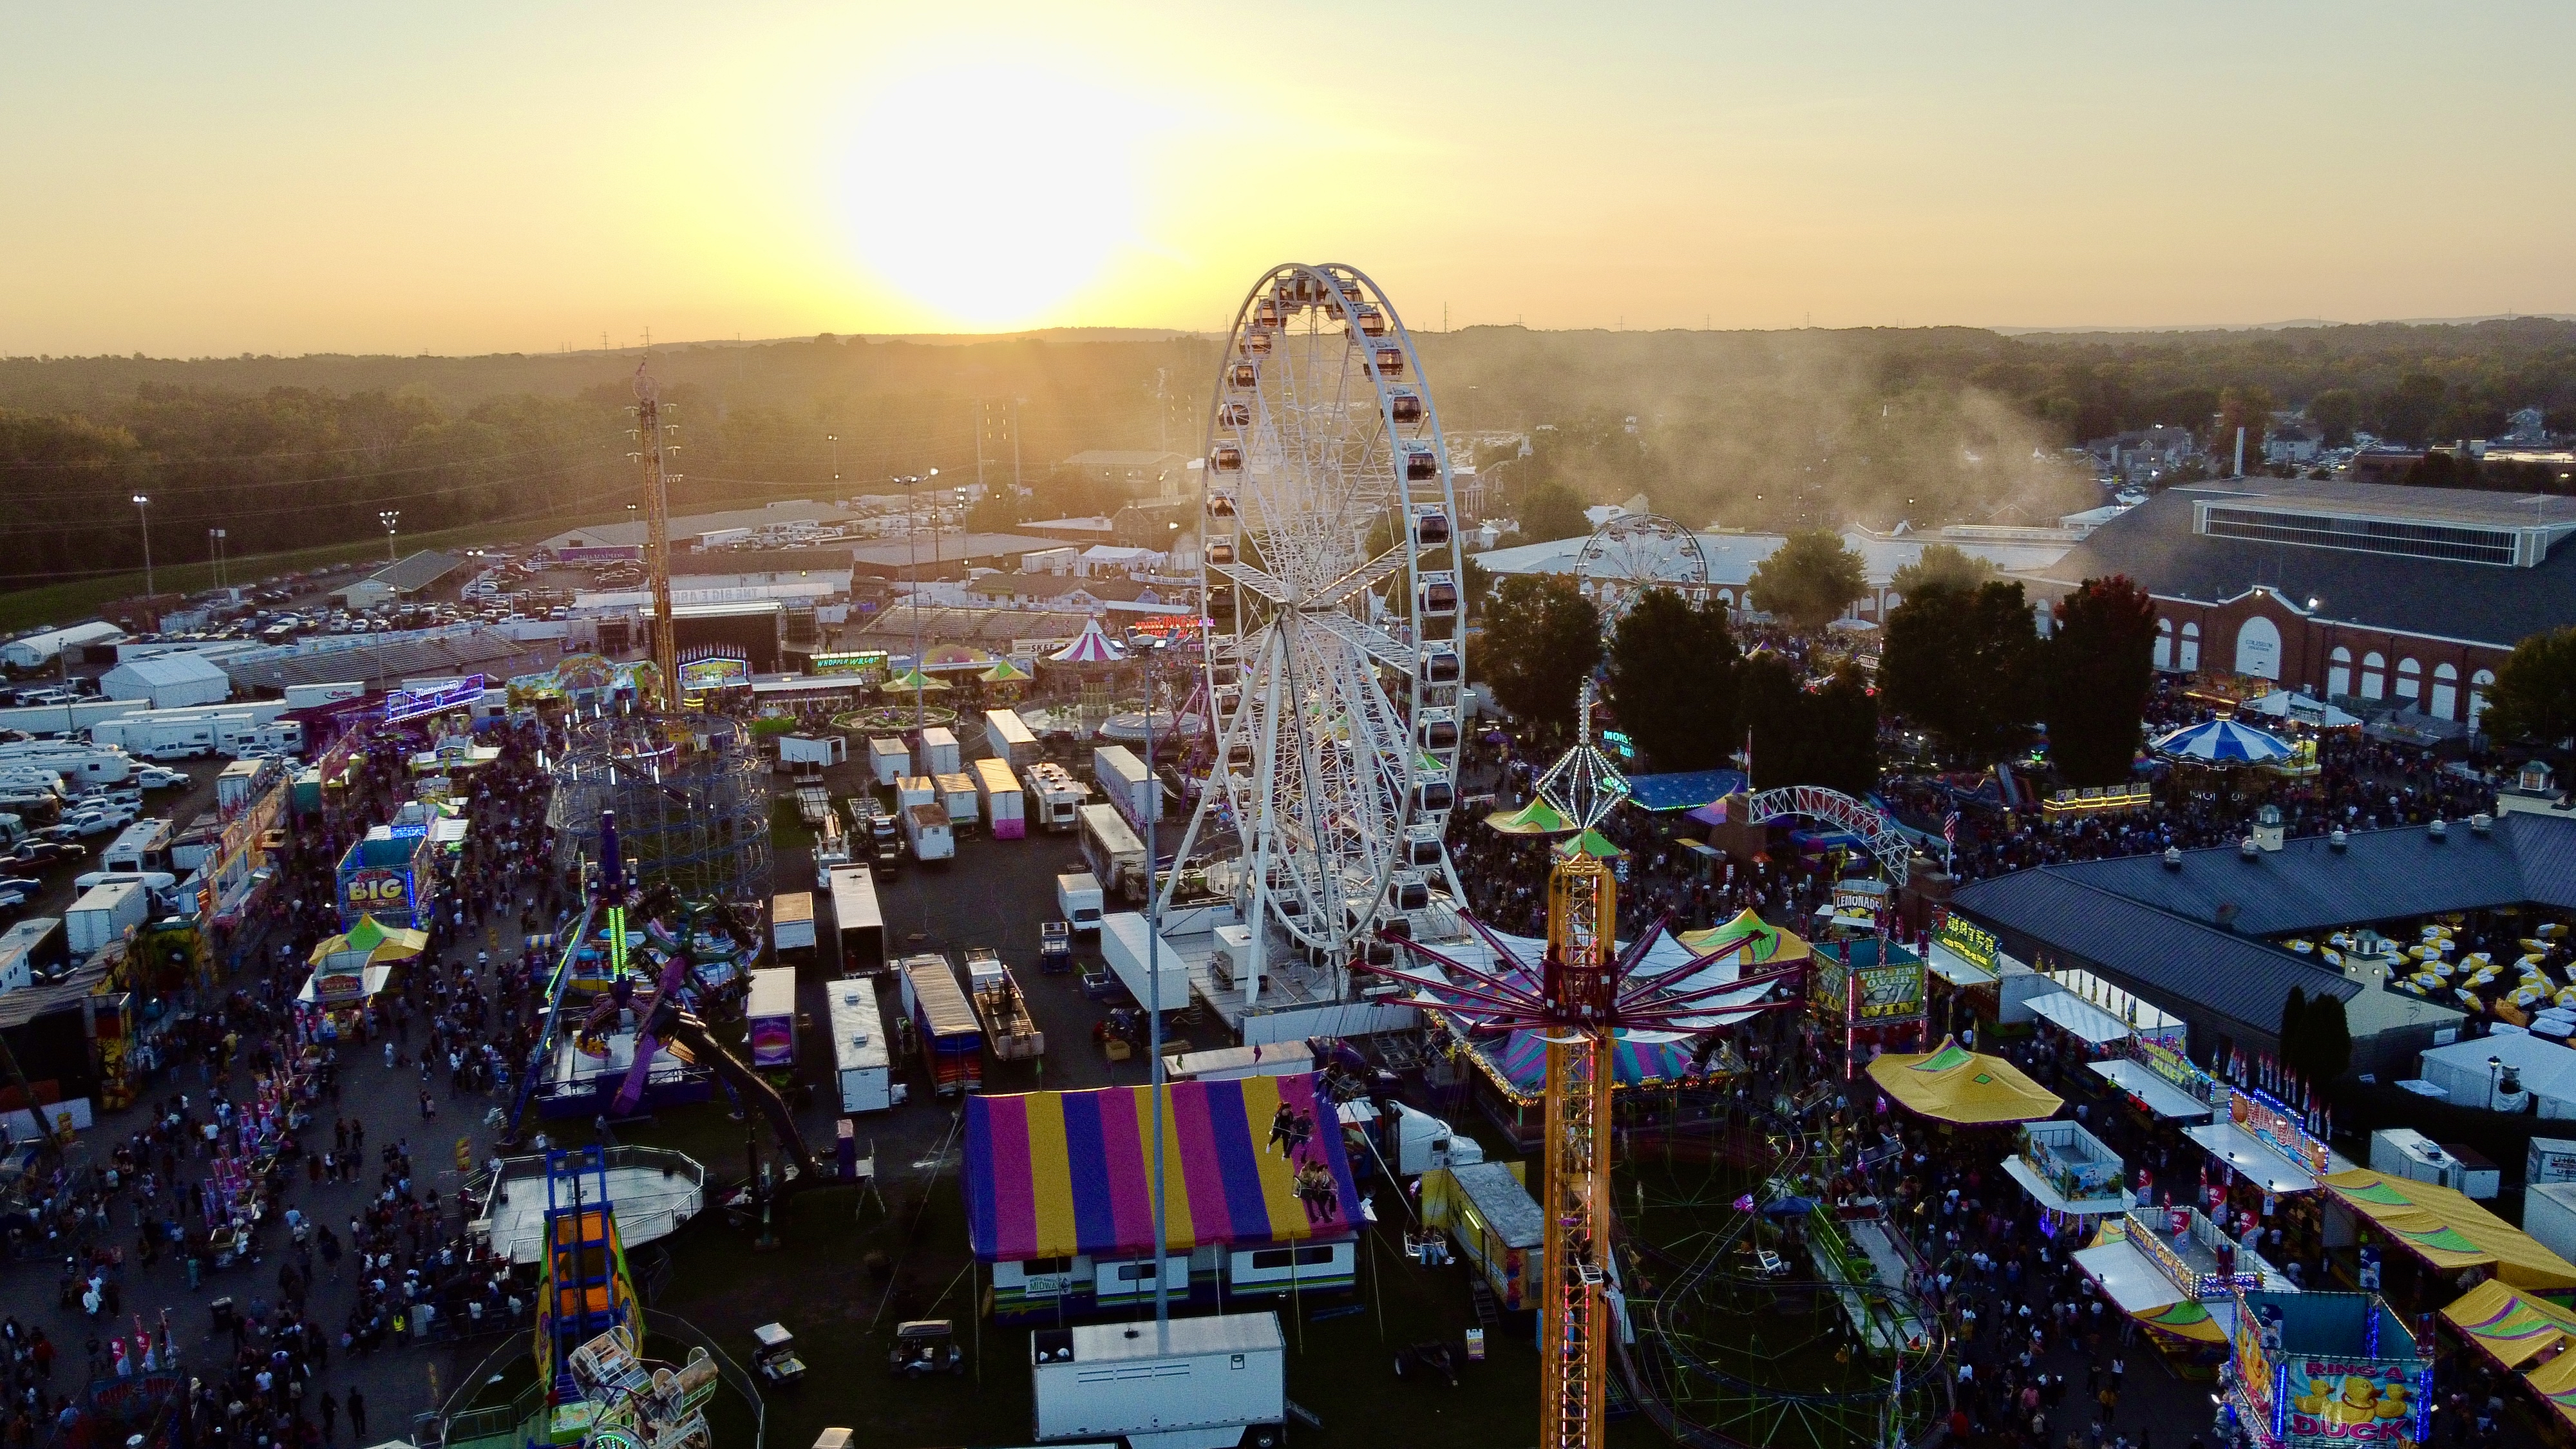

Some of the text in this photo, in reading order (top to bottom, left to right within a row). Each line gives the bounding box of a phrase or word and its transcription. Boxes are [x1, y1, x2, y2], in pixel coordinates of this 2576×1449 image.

[348, 878, 402, 901] BIG
[1836, 895, 1880, 910] LEMONADE
[1866, 976, 1911, 988] OVER
[2305, 1361, 2405, 1380] RING A
[2292, 1413, 2408, 1441] DUCK
